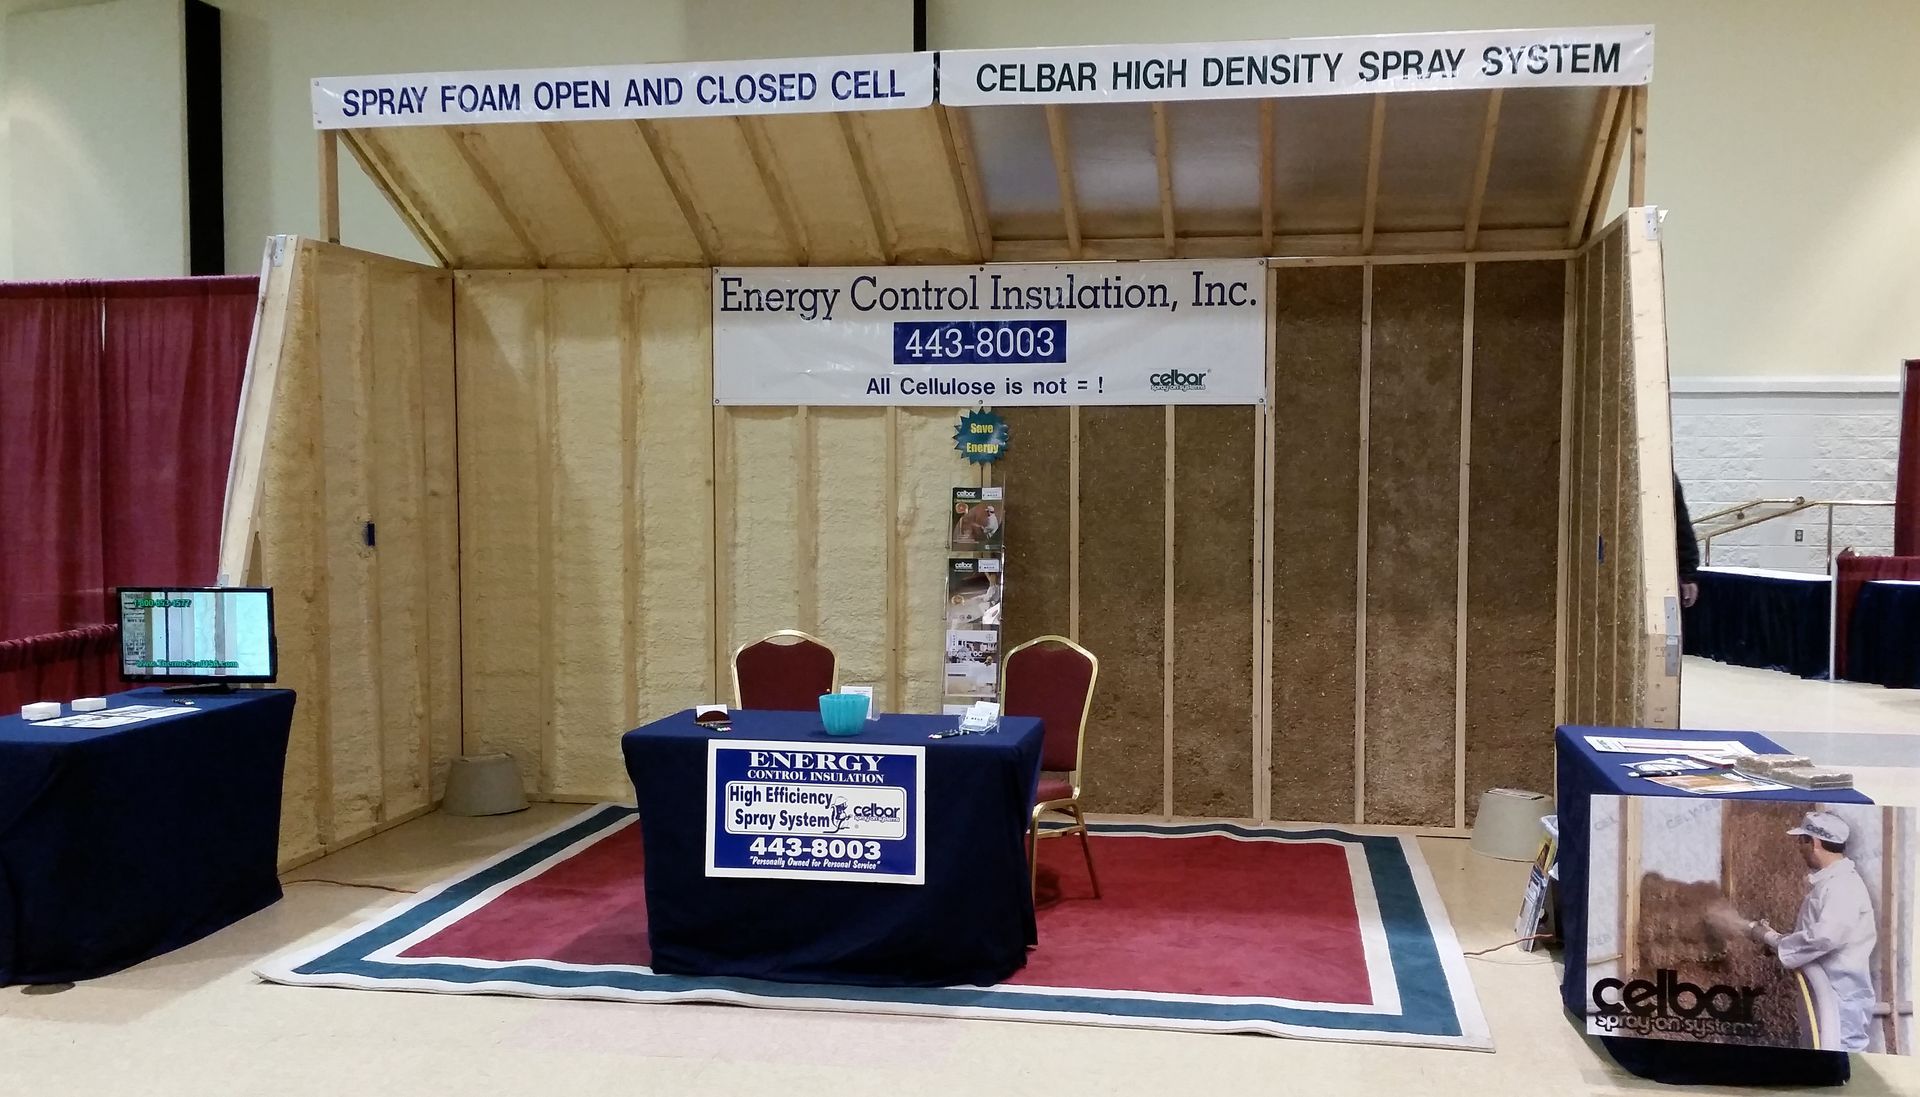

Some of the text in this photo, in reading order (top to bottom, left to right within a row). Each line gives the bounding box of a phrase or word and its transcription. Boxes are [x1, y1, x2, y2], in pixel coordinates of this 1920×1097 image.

[977, 43, 1620, 92] CELBAR HIGH DENSITY SPRAY SYSTEM
[343, 70, 905, 117] SPRAY FOAM OPEN AND CLOSED CELL
[721, 271, 1256, 320] Energy Control Insulation, Inc.
[906, 328, 1054, 357] 443-8003
[867, 377, 1102, 395] All Cellulose is not = !
[1149, 368, 1206, 387] celbar
[966, 423, 999, 453] Save Energy
[749, 752, 885, 771] ENERGY
[747, 769, 885, 784] CONTROL INSULATION
[730, 786, 833, 809] High Efficiency
[735, 809, 829, 830] Spray System
[853, 803, 900, 818] celbar
[749, 837, 882, 860] 443-8003
[787, 857, 810, 868] Owned
[811, 859, 821, 868] for
[823, 858, 851, 869] Personal
[1592, 968, 1767, 1020] celbar
